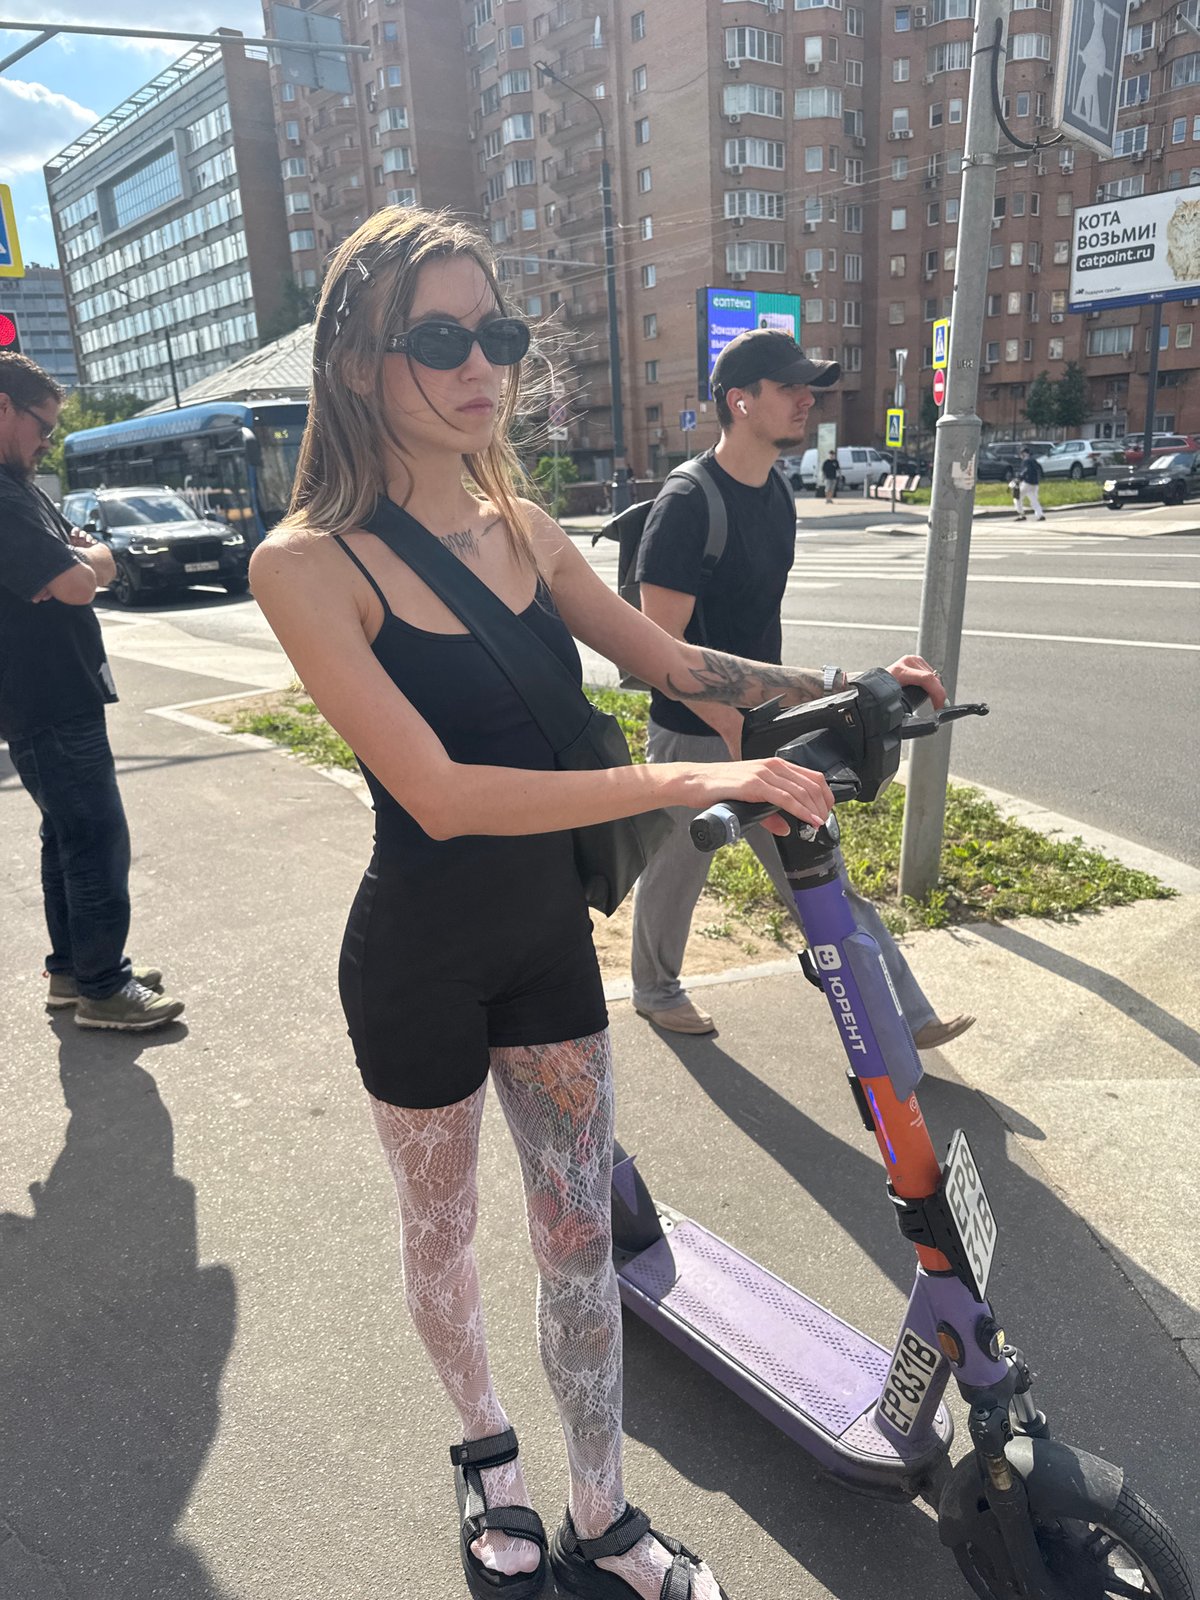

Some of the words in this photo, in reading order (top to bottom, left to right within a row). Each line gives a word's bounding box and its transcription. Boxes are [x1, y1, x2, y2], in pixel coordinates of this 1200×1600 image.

[1078, 210, 1121, 231] КОТА
[1077, 222, 1157, 251] ВОЗЬМИ!
[1079, 248, 1151, 268] catpoint.ru
[828, 976, 867, 1055] ЮРЕНТ
